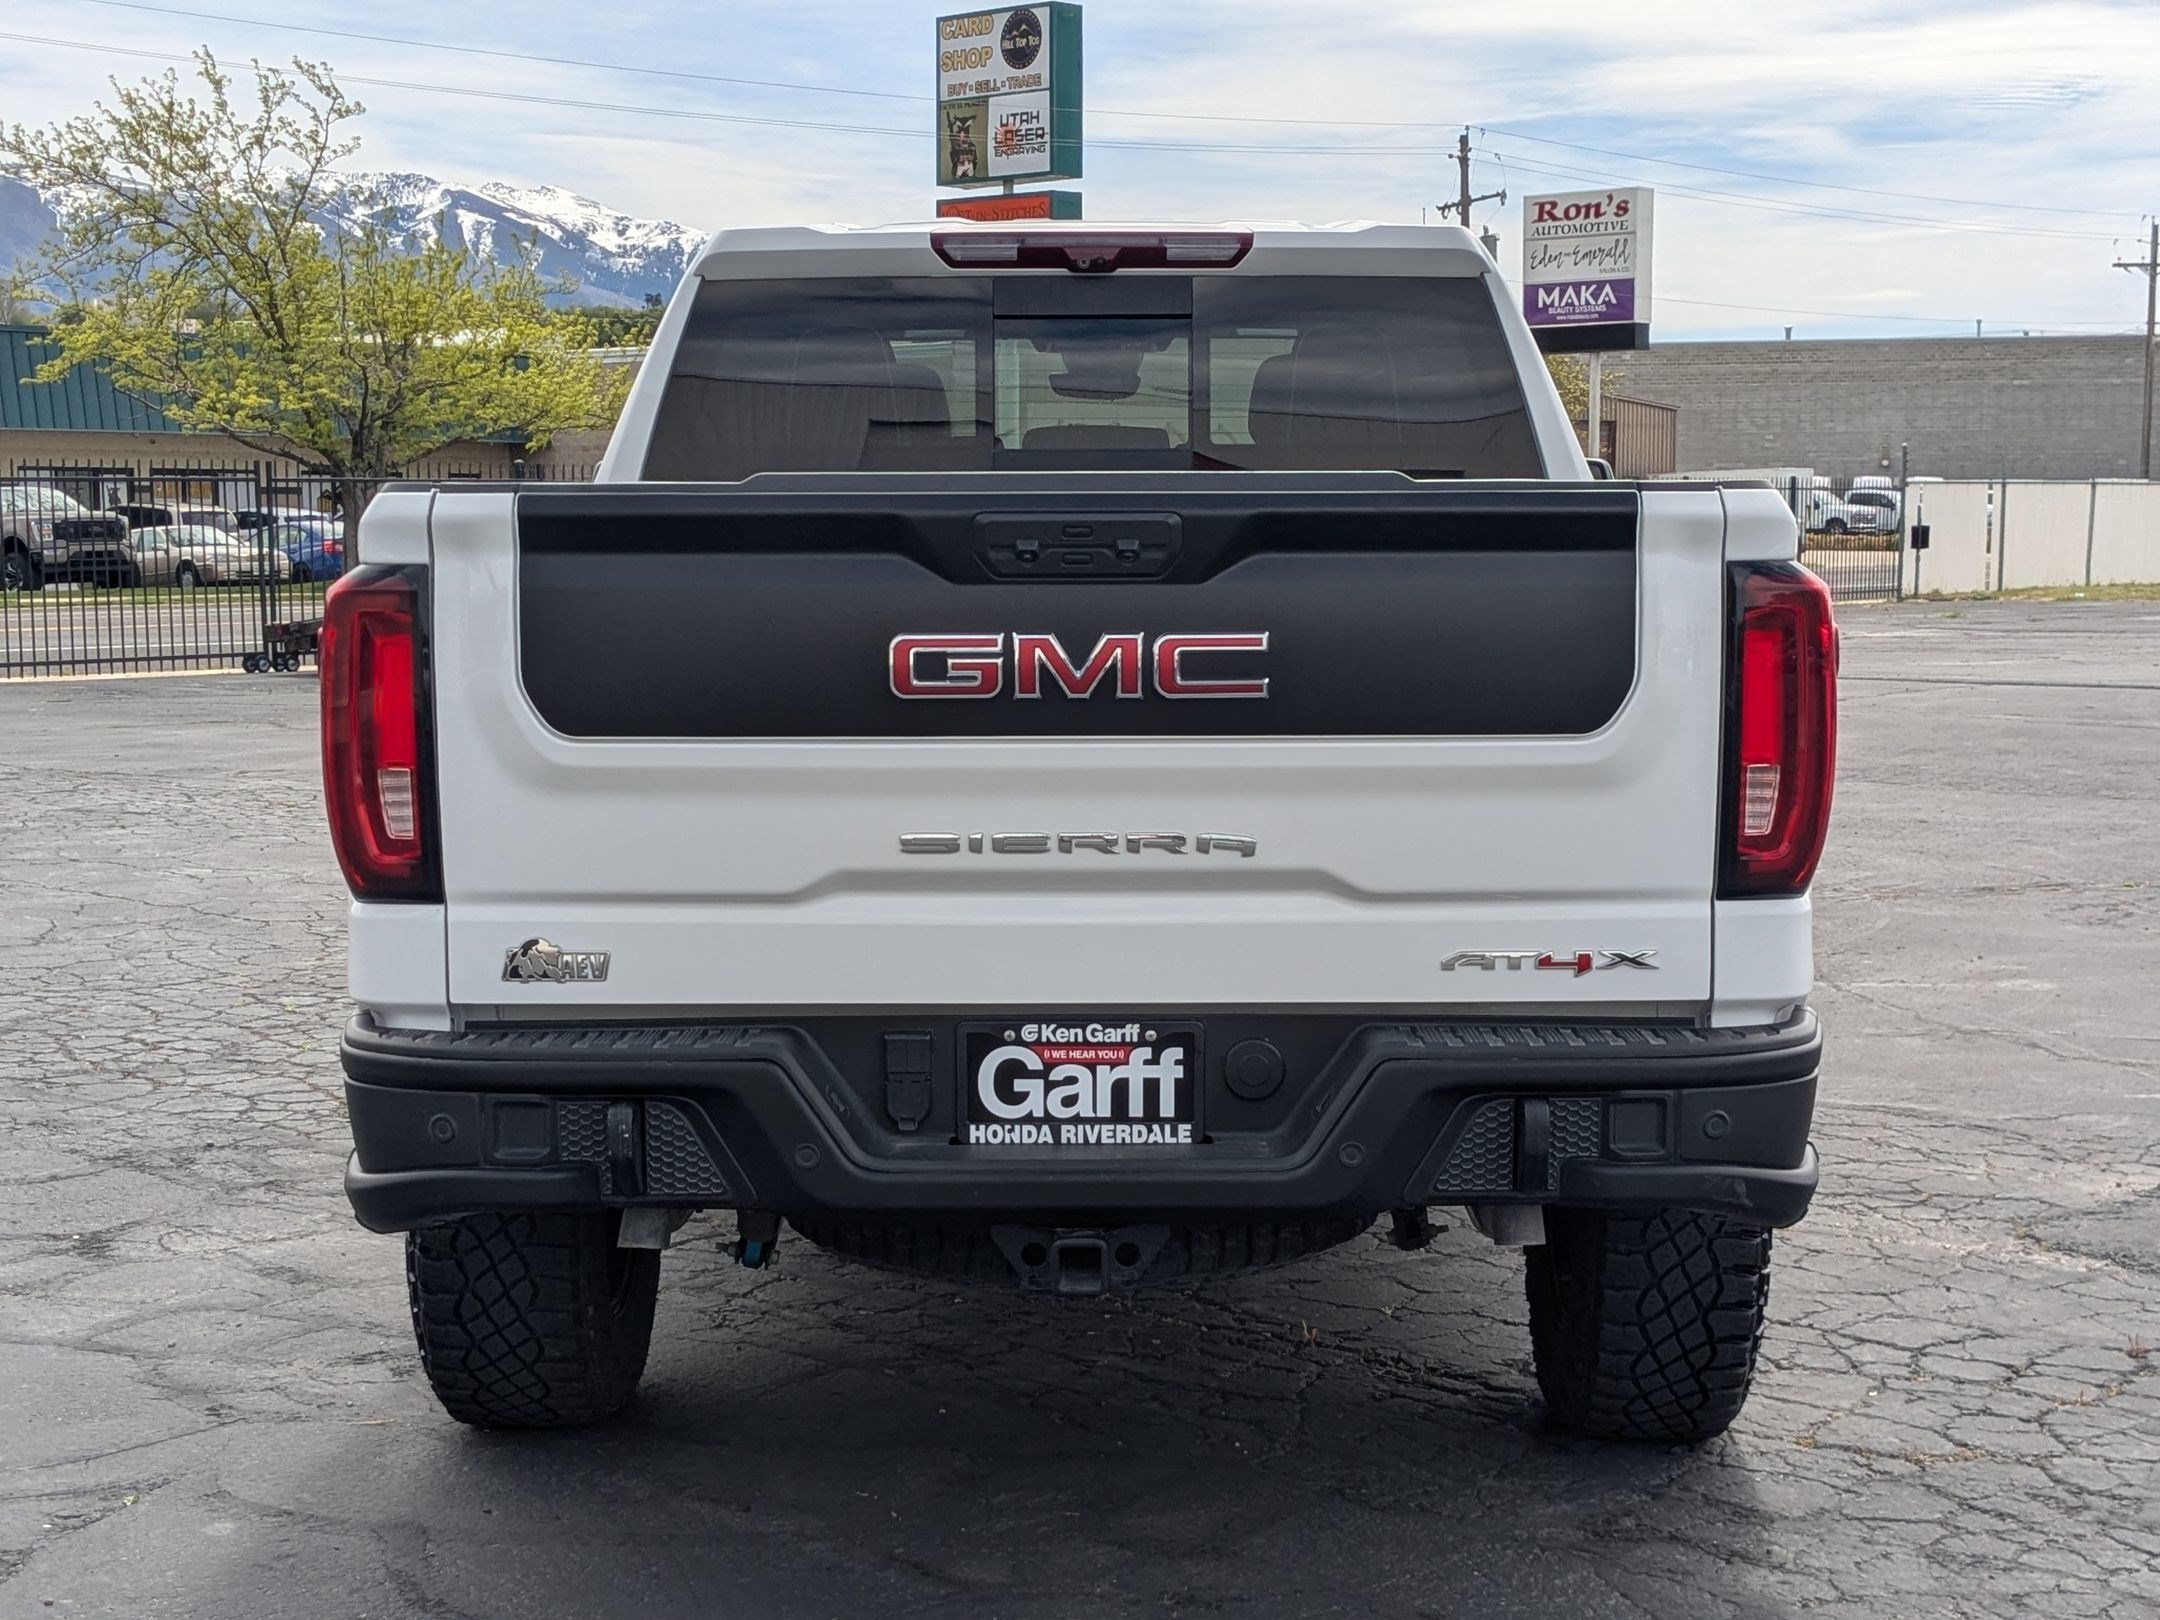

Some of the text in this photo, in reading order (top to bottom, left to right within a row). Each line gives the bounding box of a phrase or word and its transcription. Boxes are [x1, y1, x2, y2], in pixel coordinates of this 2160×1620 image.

[941, 13, 994, 40] CARD
[941, 46, 993, 72] SHOP
[947, 73, 1042, 97] BUY SELL TRADE
[1000, 110, 1039, 128] UTAH
[994, 127, 1045, 144] LASER
[994, 145, 1046, 157] ENGRAVING
[1531, 192, 1630, 223] Ron's
[1531, 220, 1629, 237] AUTOMOTIVE
[1530, 243, 1564, 270] Eden
[1572, 238, 1631, 267] Emerald
[1538, 283, 1617, 308] MAKA
[1548, 304, 1607, 314] BEAUTY SYSTEMS
[889, 631, 1269, 699] GMC
[899, 832, 1258, 858] SIERRA
[561, 953, 606, 979] AEV
[1441, 950, 1659, 977] AT4X
[1041, 1023, 1141, 1042] Ken Garff
[1052, 1049, 1118, 1059] WE HEAR YOU
[977, 1045, 1184, 1119] Garff
[969, 1124, 1192, 1144] HONDA RIVERDALE
